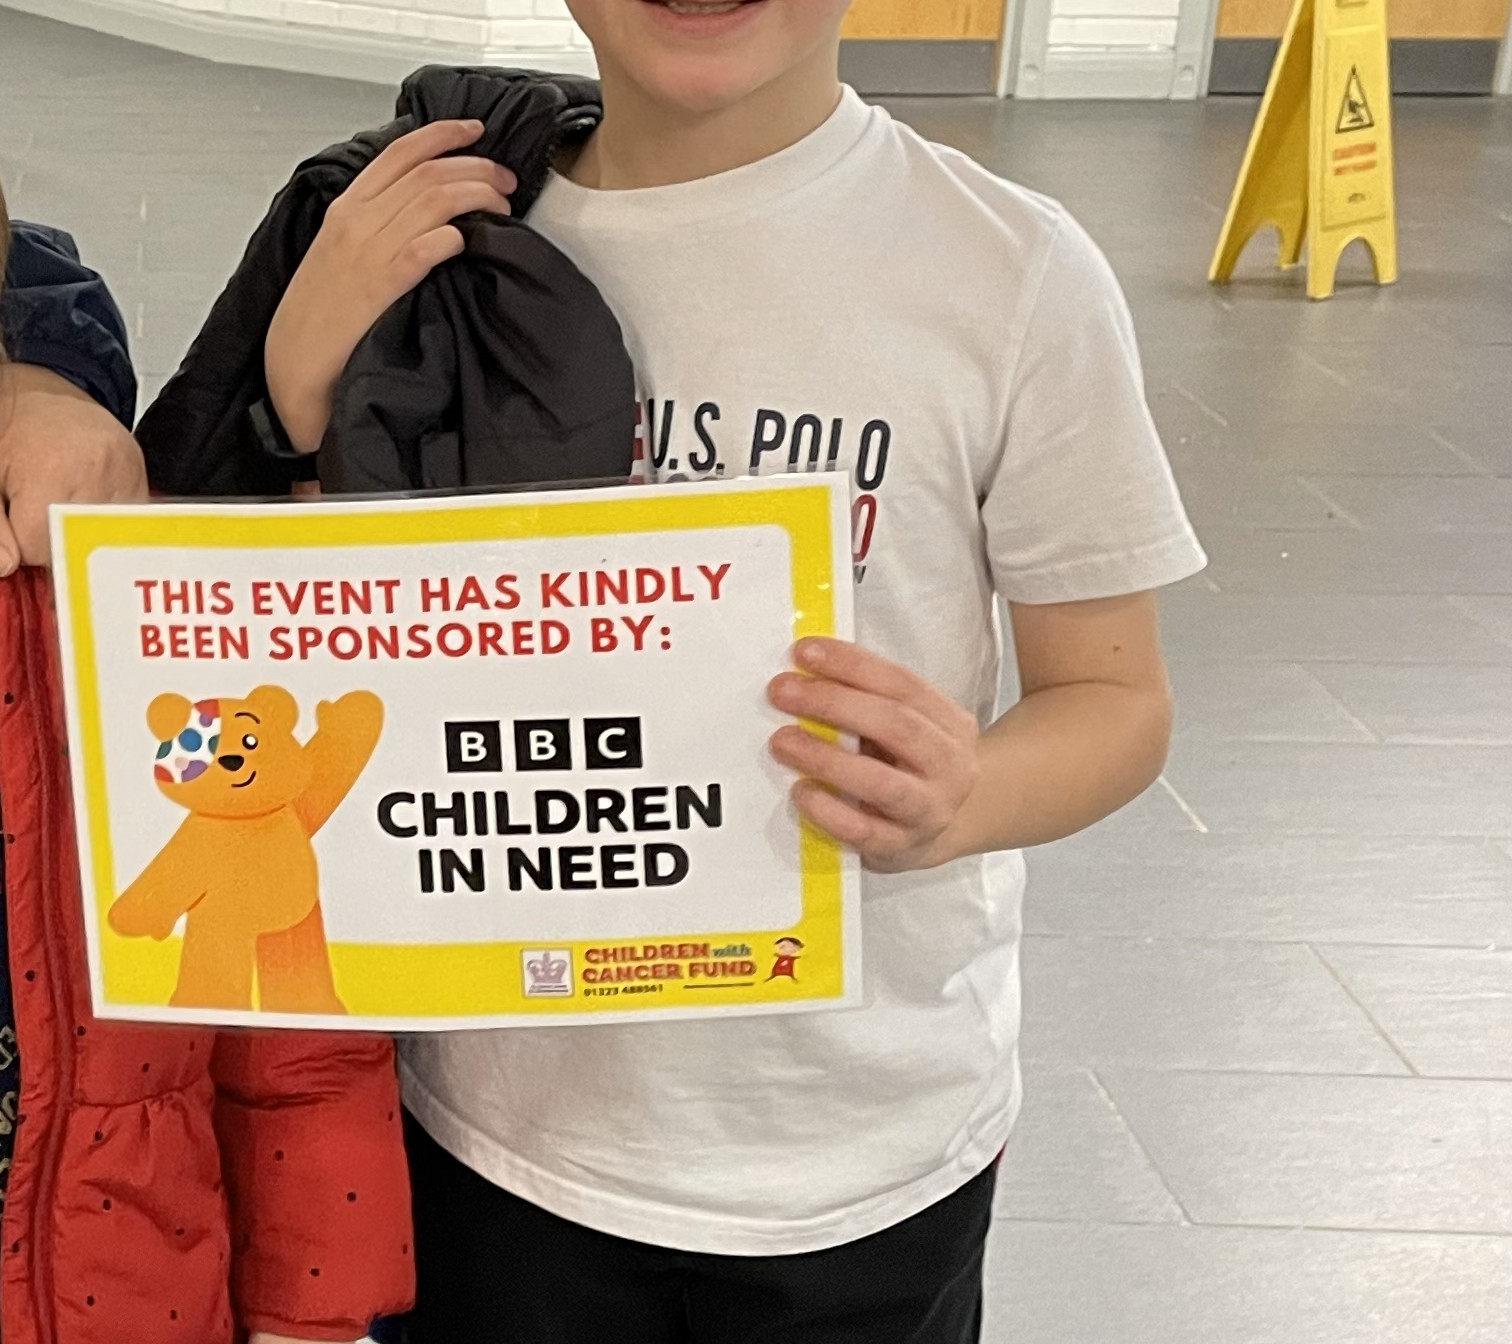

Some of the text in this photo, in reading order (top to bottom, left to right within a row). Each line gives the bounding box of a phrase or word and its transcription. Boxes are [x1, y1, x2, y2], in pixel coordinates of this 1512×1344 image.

[647, 399, 726, 473] U.S.
[135, 563, 730, 616] THIS EVENT HAS KINDLY
[139, 614, 673, 660] BEEN SPONSORED BY:
[451, 720, 638, 770] BBC
[378, 784, 722, 838] CHILDREN
[418, 843, 689, 893] IN NEED
[582, 960, 757, 984] CANCER FUND
[584, 943, 752, 964] CHILDREN with
